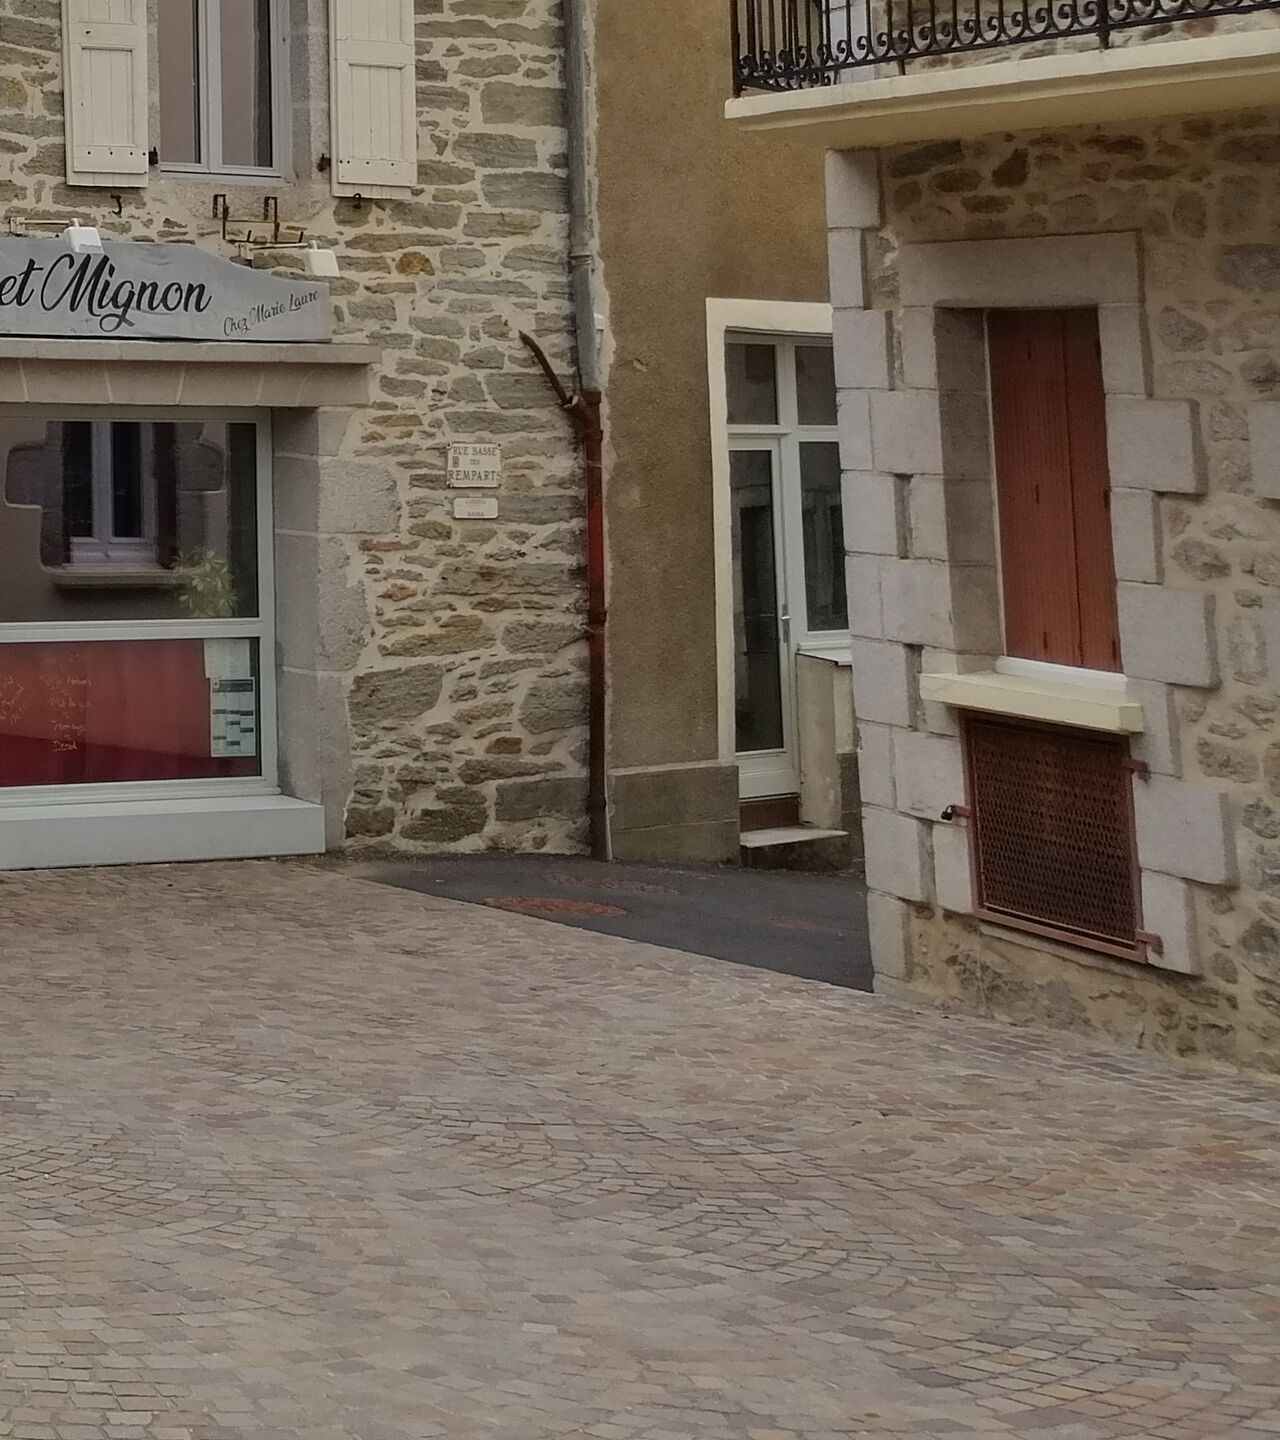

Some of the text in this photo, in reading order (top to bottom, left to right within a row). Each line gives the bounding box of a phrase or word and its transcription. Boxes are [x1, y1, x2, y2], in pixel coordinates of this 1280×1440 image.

[40, 253, 212, 333] Mignon
[223, 290, 319, 337] Chez Marie Laure
[453, 446, 497, 456] RUE BASSE
[448, 470, 502, 481] REMPARTS
